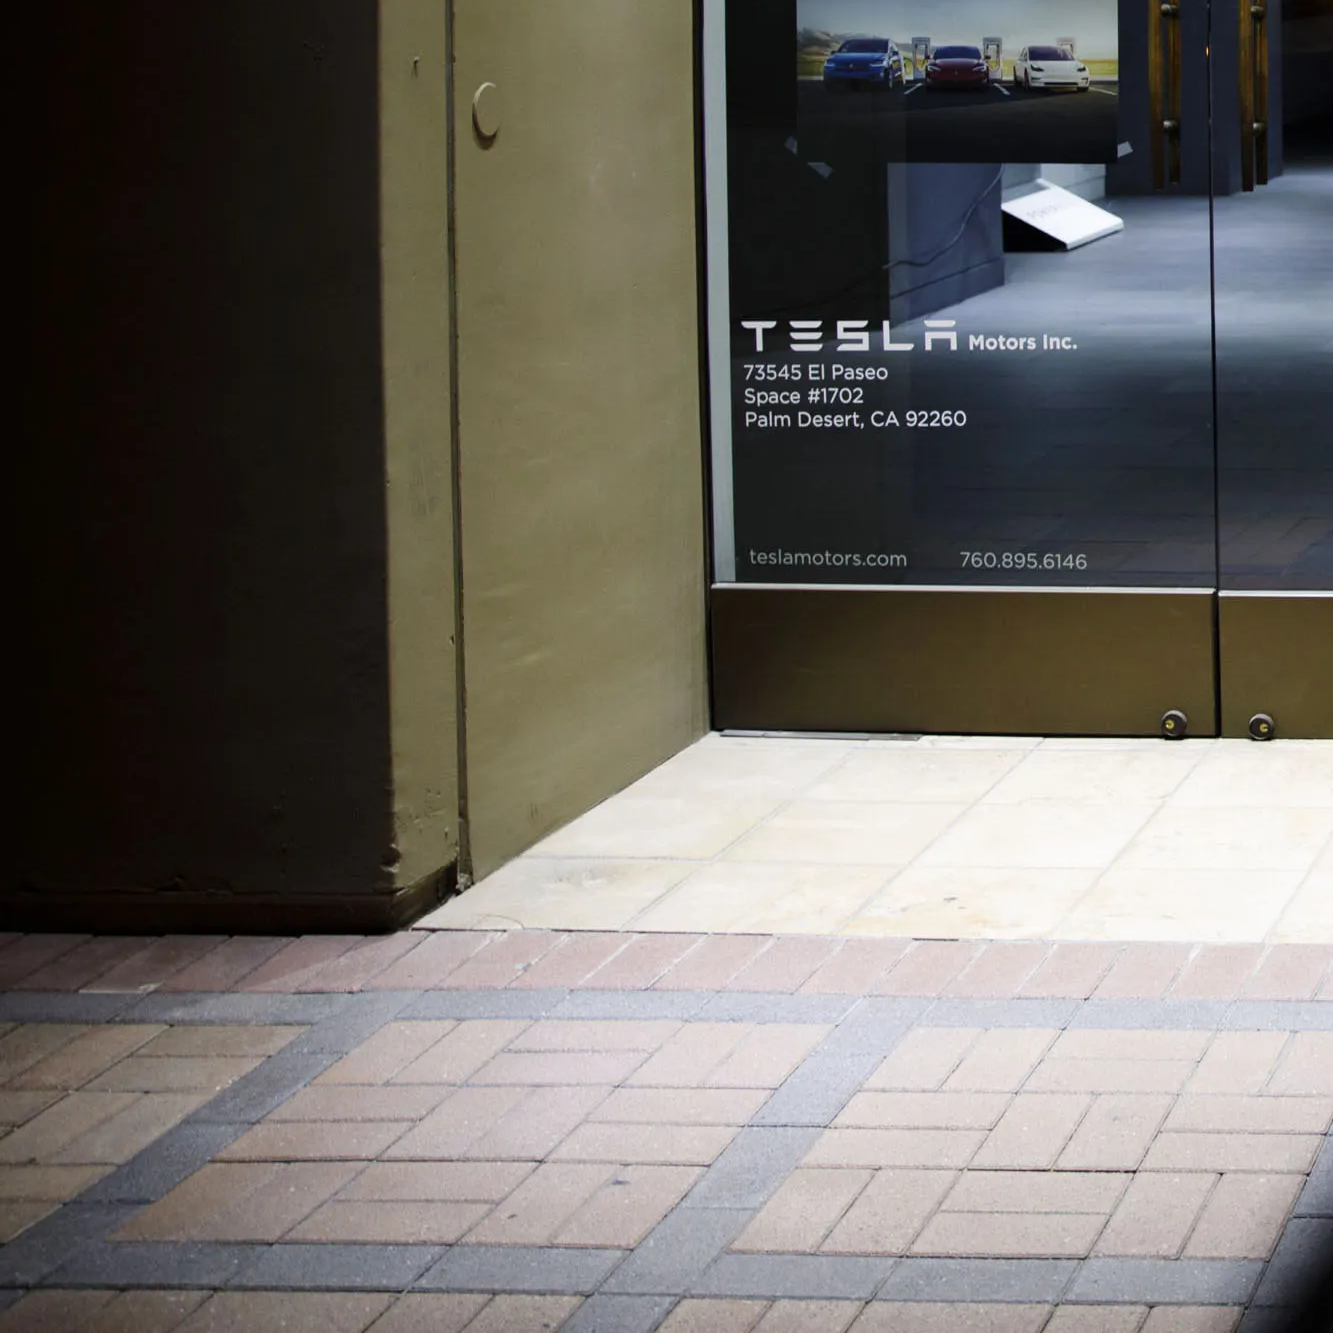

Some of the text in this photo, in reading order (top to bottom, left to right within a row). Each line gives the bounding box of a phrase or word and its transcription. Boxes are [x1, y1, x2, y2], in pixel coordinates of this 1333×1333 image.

[741, 320, 1078, 353] TESLA Motors Inc.
[743, 363, 889, 381] 73545 El Paseo
[744, 387, 864, 406] Space #1702
[745, 410, 968, 429] Palm Desert, CA 92260
[749, 548, 908, 567] teslamotors.com
[960, 551, 1088, 570] 760.895.6146
